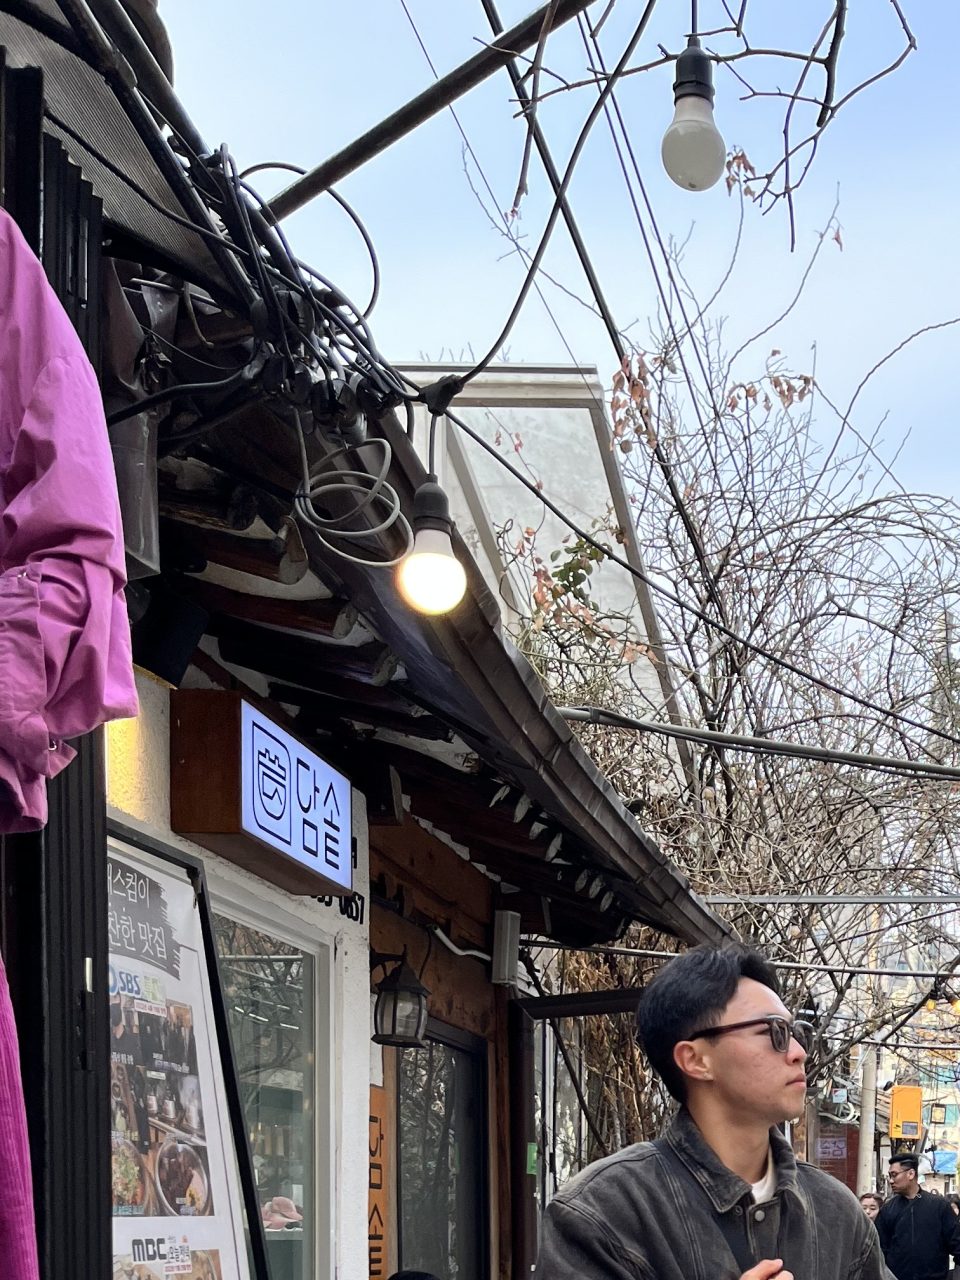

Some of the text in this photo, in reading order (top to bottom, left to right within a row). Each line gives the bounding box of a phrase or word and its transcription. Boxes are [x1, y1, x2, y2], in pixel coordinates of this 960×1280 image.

[296, 757, 341, 870] 담솥
[138, 921, 168, 961] 맛집
[119, 971, 141, 996] SBS
[131, 1237, 168, 1262] MBC
